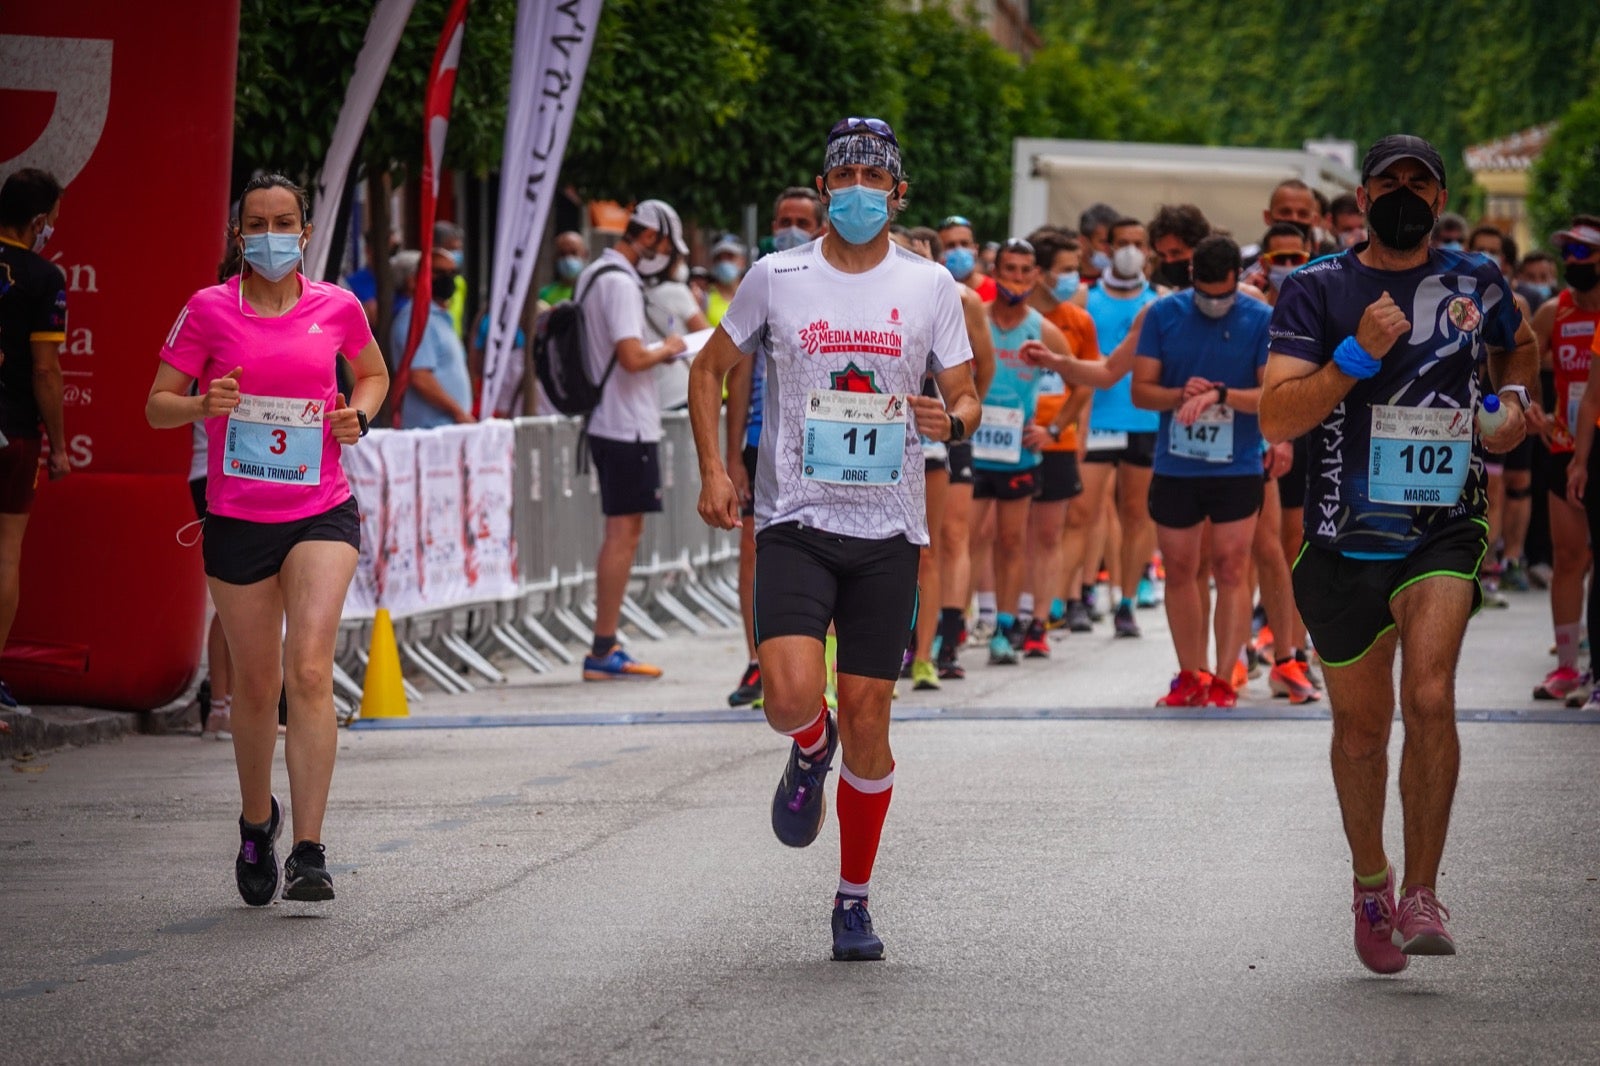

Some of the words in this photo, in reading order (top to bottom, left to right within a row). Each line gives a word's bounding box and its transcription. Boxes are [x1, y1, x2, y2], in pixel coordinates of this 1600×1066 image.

[809, 318, 829, 333] edp
[798, 328, 819, 355] 38
[819, 330, 852, 344] MEDIA
[854, 329, 902, 348] MARATÓN
[269, 428, 287, 455] 3
[843, 427, 878, 456] 11
[1185, 425, 1220, 443] 147
[1373, 452, 1381, 476] MASTER
[1399, 444, 1453, 474] 102
[239, 463, 265, 478] MARIA
[267, 466, 305, 481] TRINIDAD
[841, 468, 869, 482] JORGE
[1403, 488, 1441, 502] MARCOS
